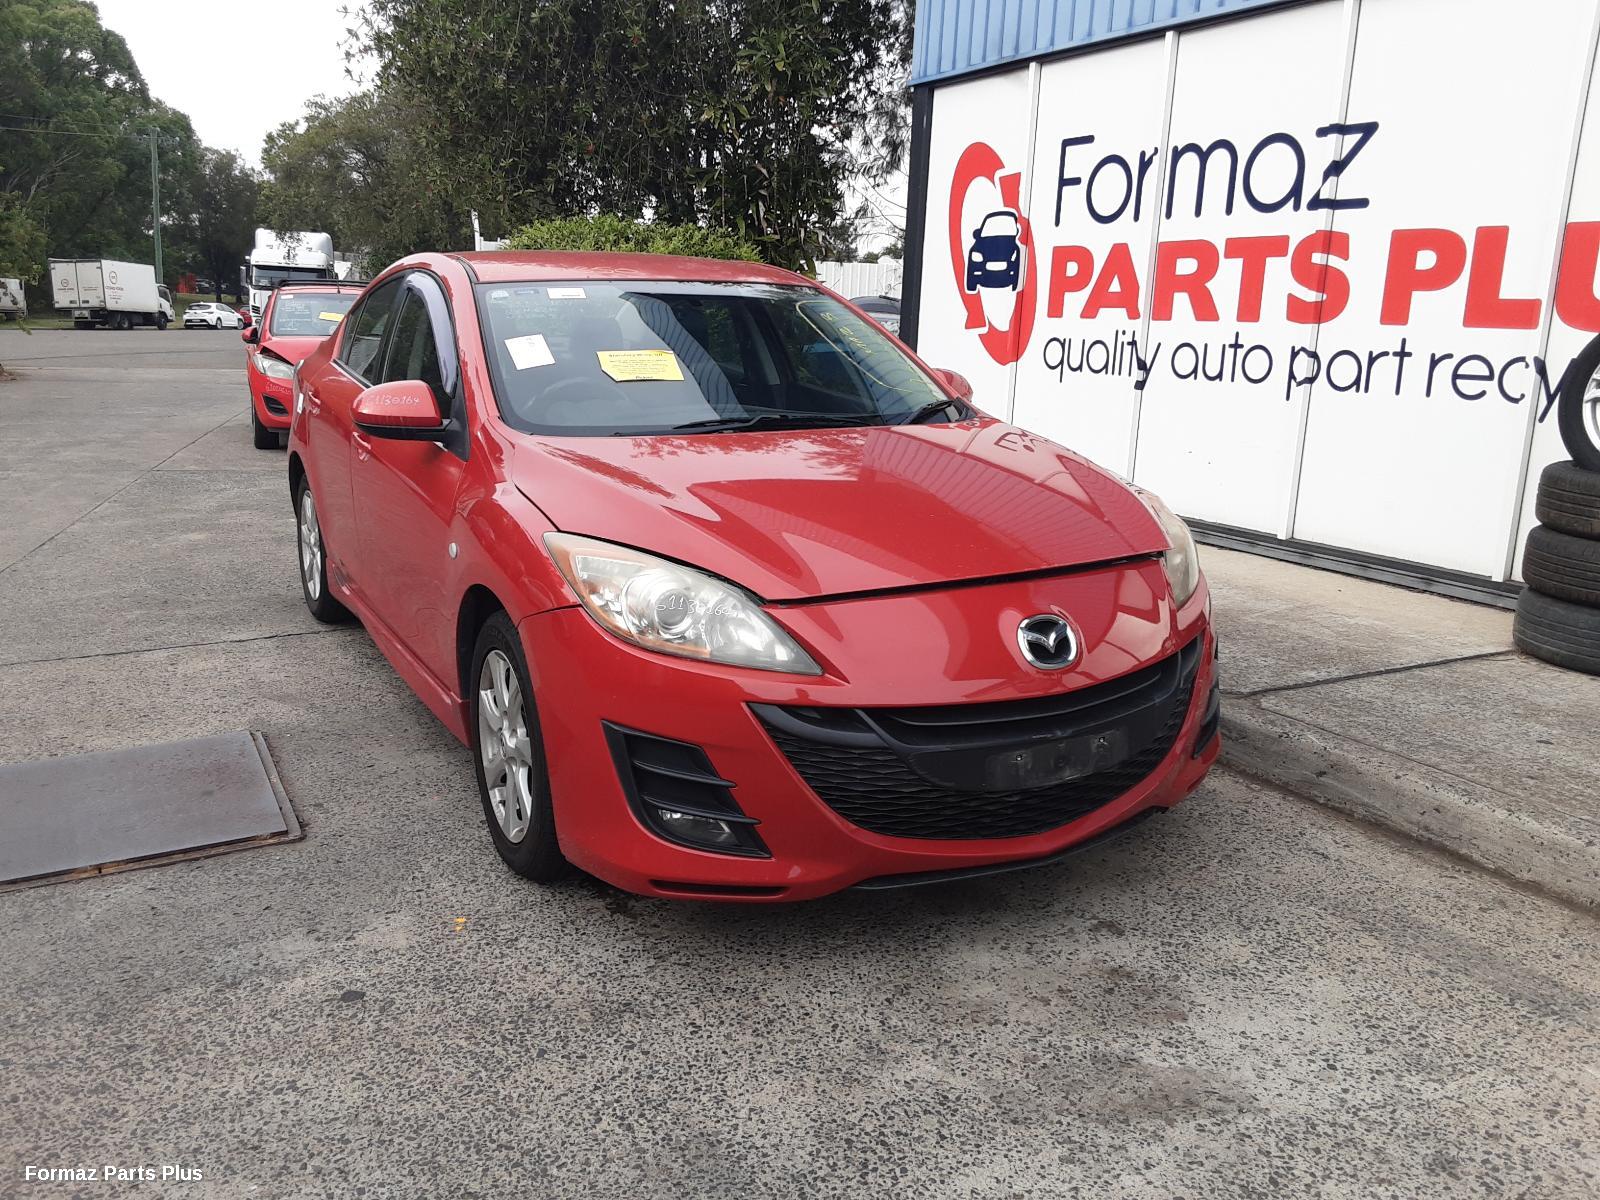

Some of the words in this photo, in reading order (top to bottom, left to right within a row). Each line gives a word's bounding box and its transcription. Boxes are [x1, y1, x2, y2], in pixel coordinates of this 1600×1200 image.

[1054, 121, 1379, 227] Formaz
[1047, 230, 1351, 323] PARTS
[1043, 330, 1162, 391] quality
[1171, 331, 1273, 385] auto
[1285, 337, 1413, 402] part
